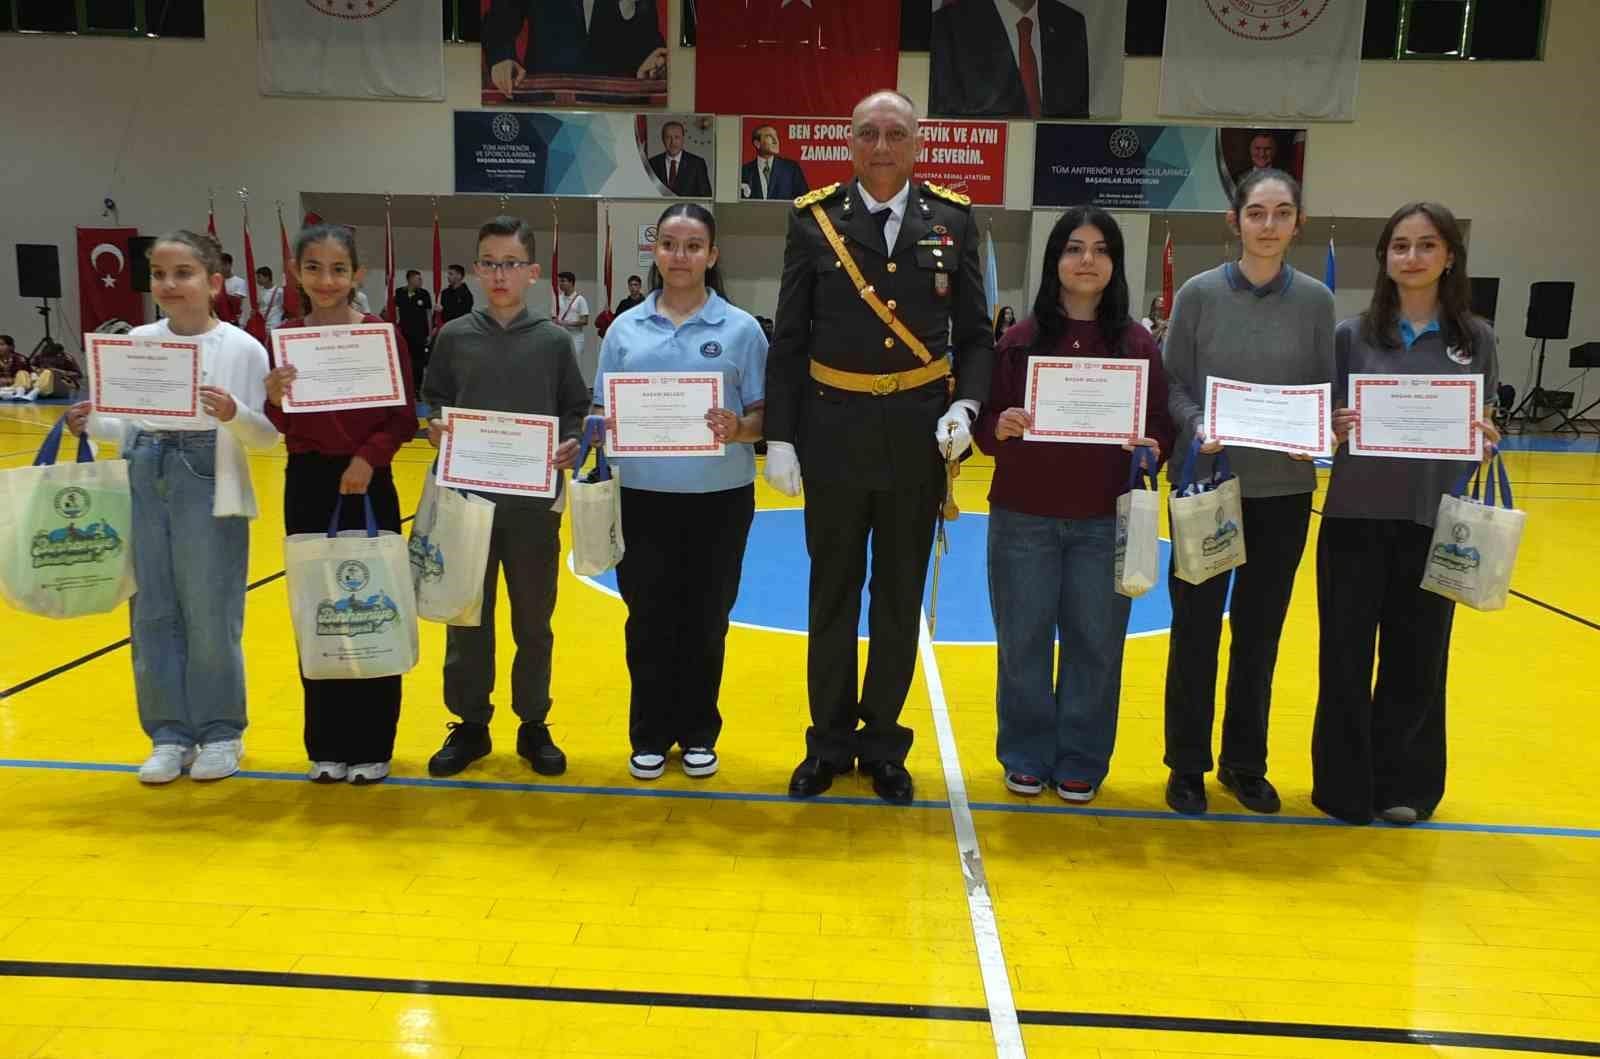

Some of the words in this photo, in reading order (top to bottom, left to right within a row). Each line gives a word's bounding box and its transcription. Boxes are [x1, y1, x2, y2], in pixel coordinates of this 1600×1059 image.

[788, 124, 811, 140] BEN
[814, 124, 853, 140] SPORC
[953, 127, 968, 143] VE
[970, 128, 998, 144] AYNI
[931, 145, 984, 165] SEVERİM.
[1051, 165, 1070, 175] TÜM
[1070, 165, 1113, 176] ANTRENÖR
